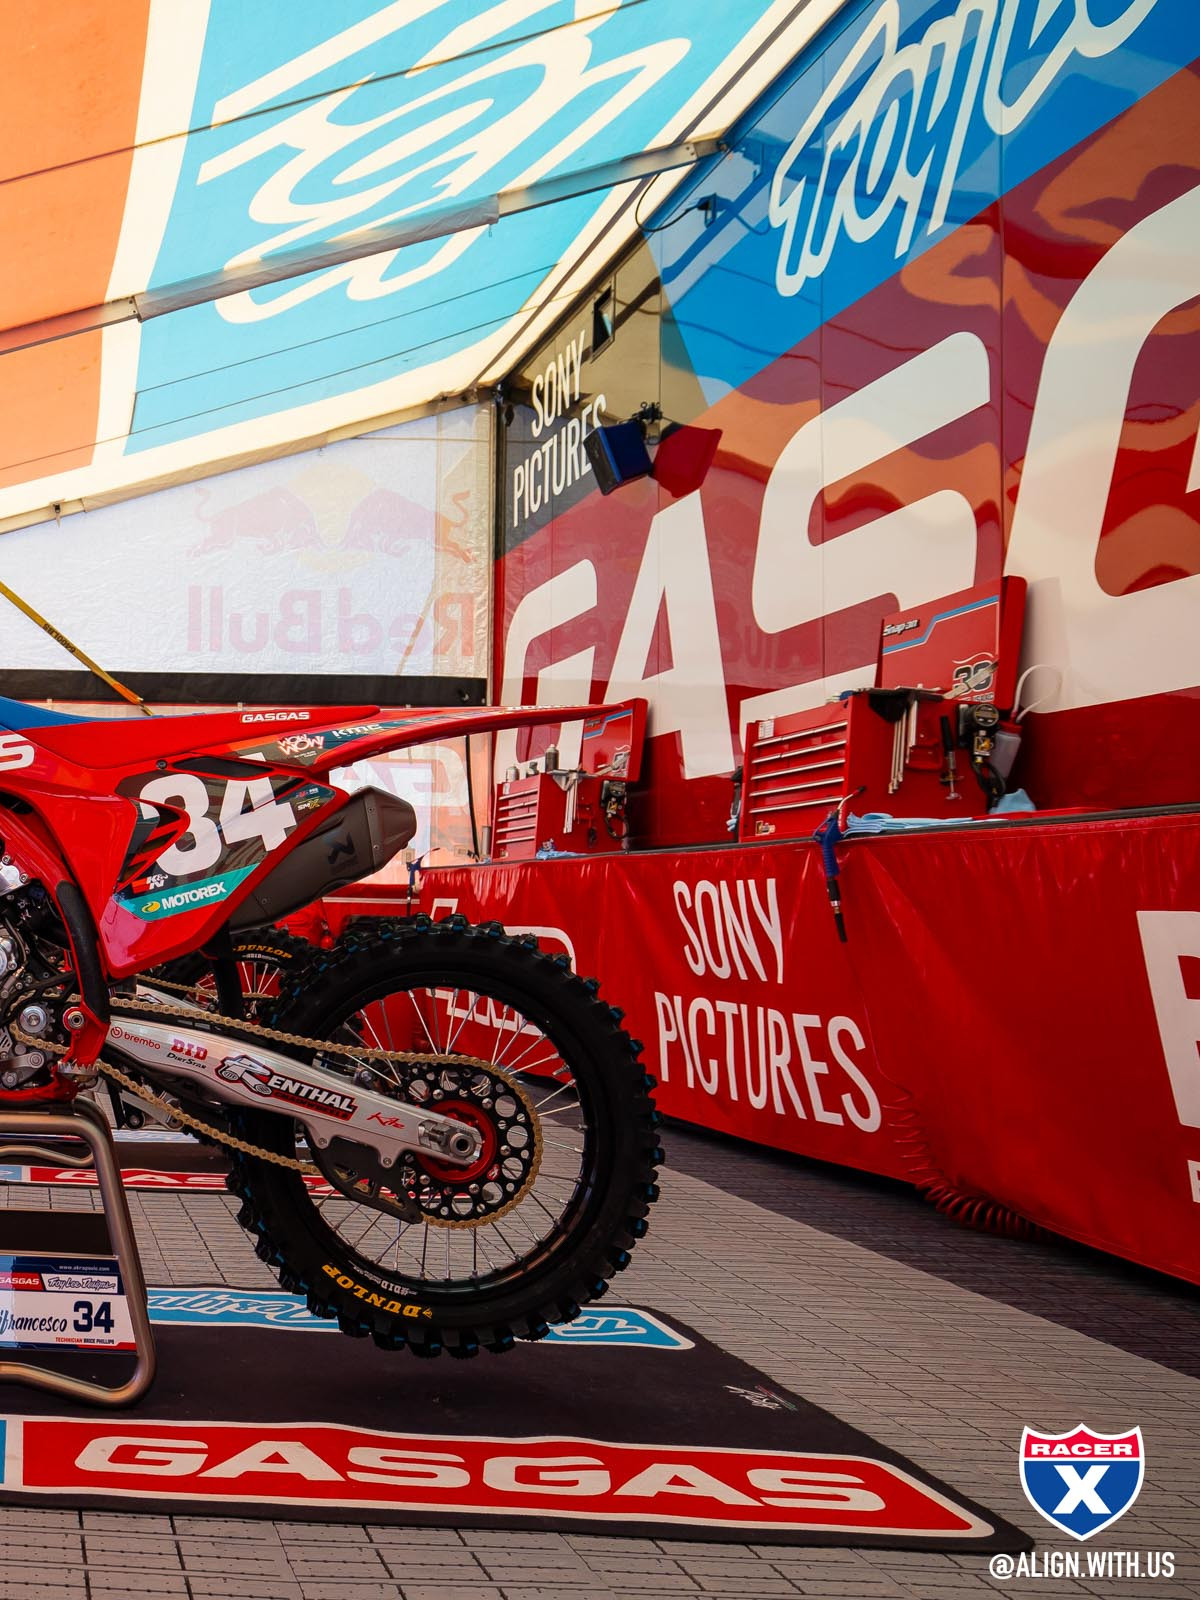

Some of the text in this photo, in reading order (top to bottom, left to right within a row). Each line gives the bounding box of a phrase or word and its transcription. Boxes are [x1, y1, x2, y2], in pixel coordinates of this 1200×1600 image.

[531, 329, 586, 437] SONY
[241, 712, 310, 723] GASGAS
[139, 752, 297, 876] 34
[162, 881, 228, 910] MOTOREX
[236, 944, 293, 959] DUNLOP
[672, 878, 785, 985] SONY
[124, 1031, 161, 1050] brembo
[654, 990, 882, 1133] PICTURES
[73, 1300, 115, 1334] 34
[321, 1264, 422, 1318] DUNLOP
[74, 1435, 887, 1512] GASGAS
